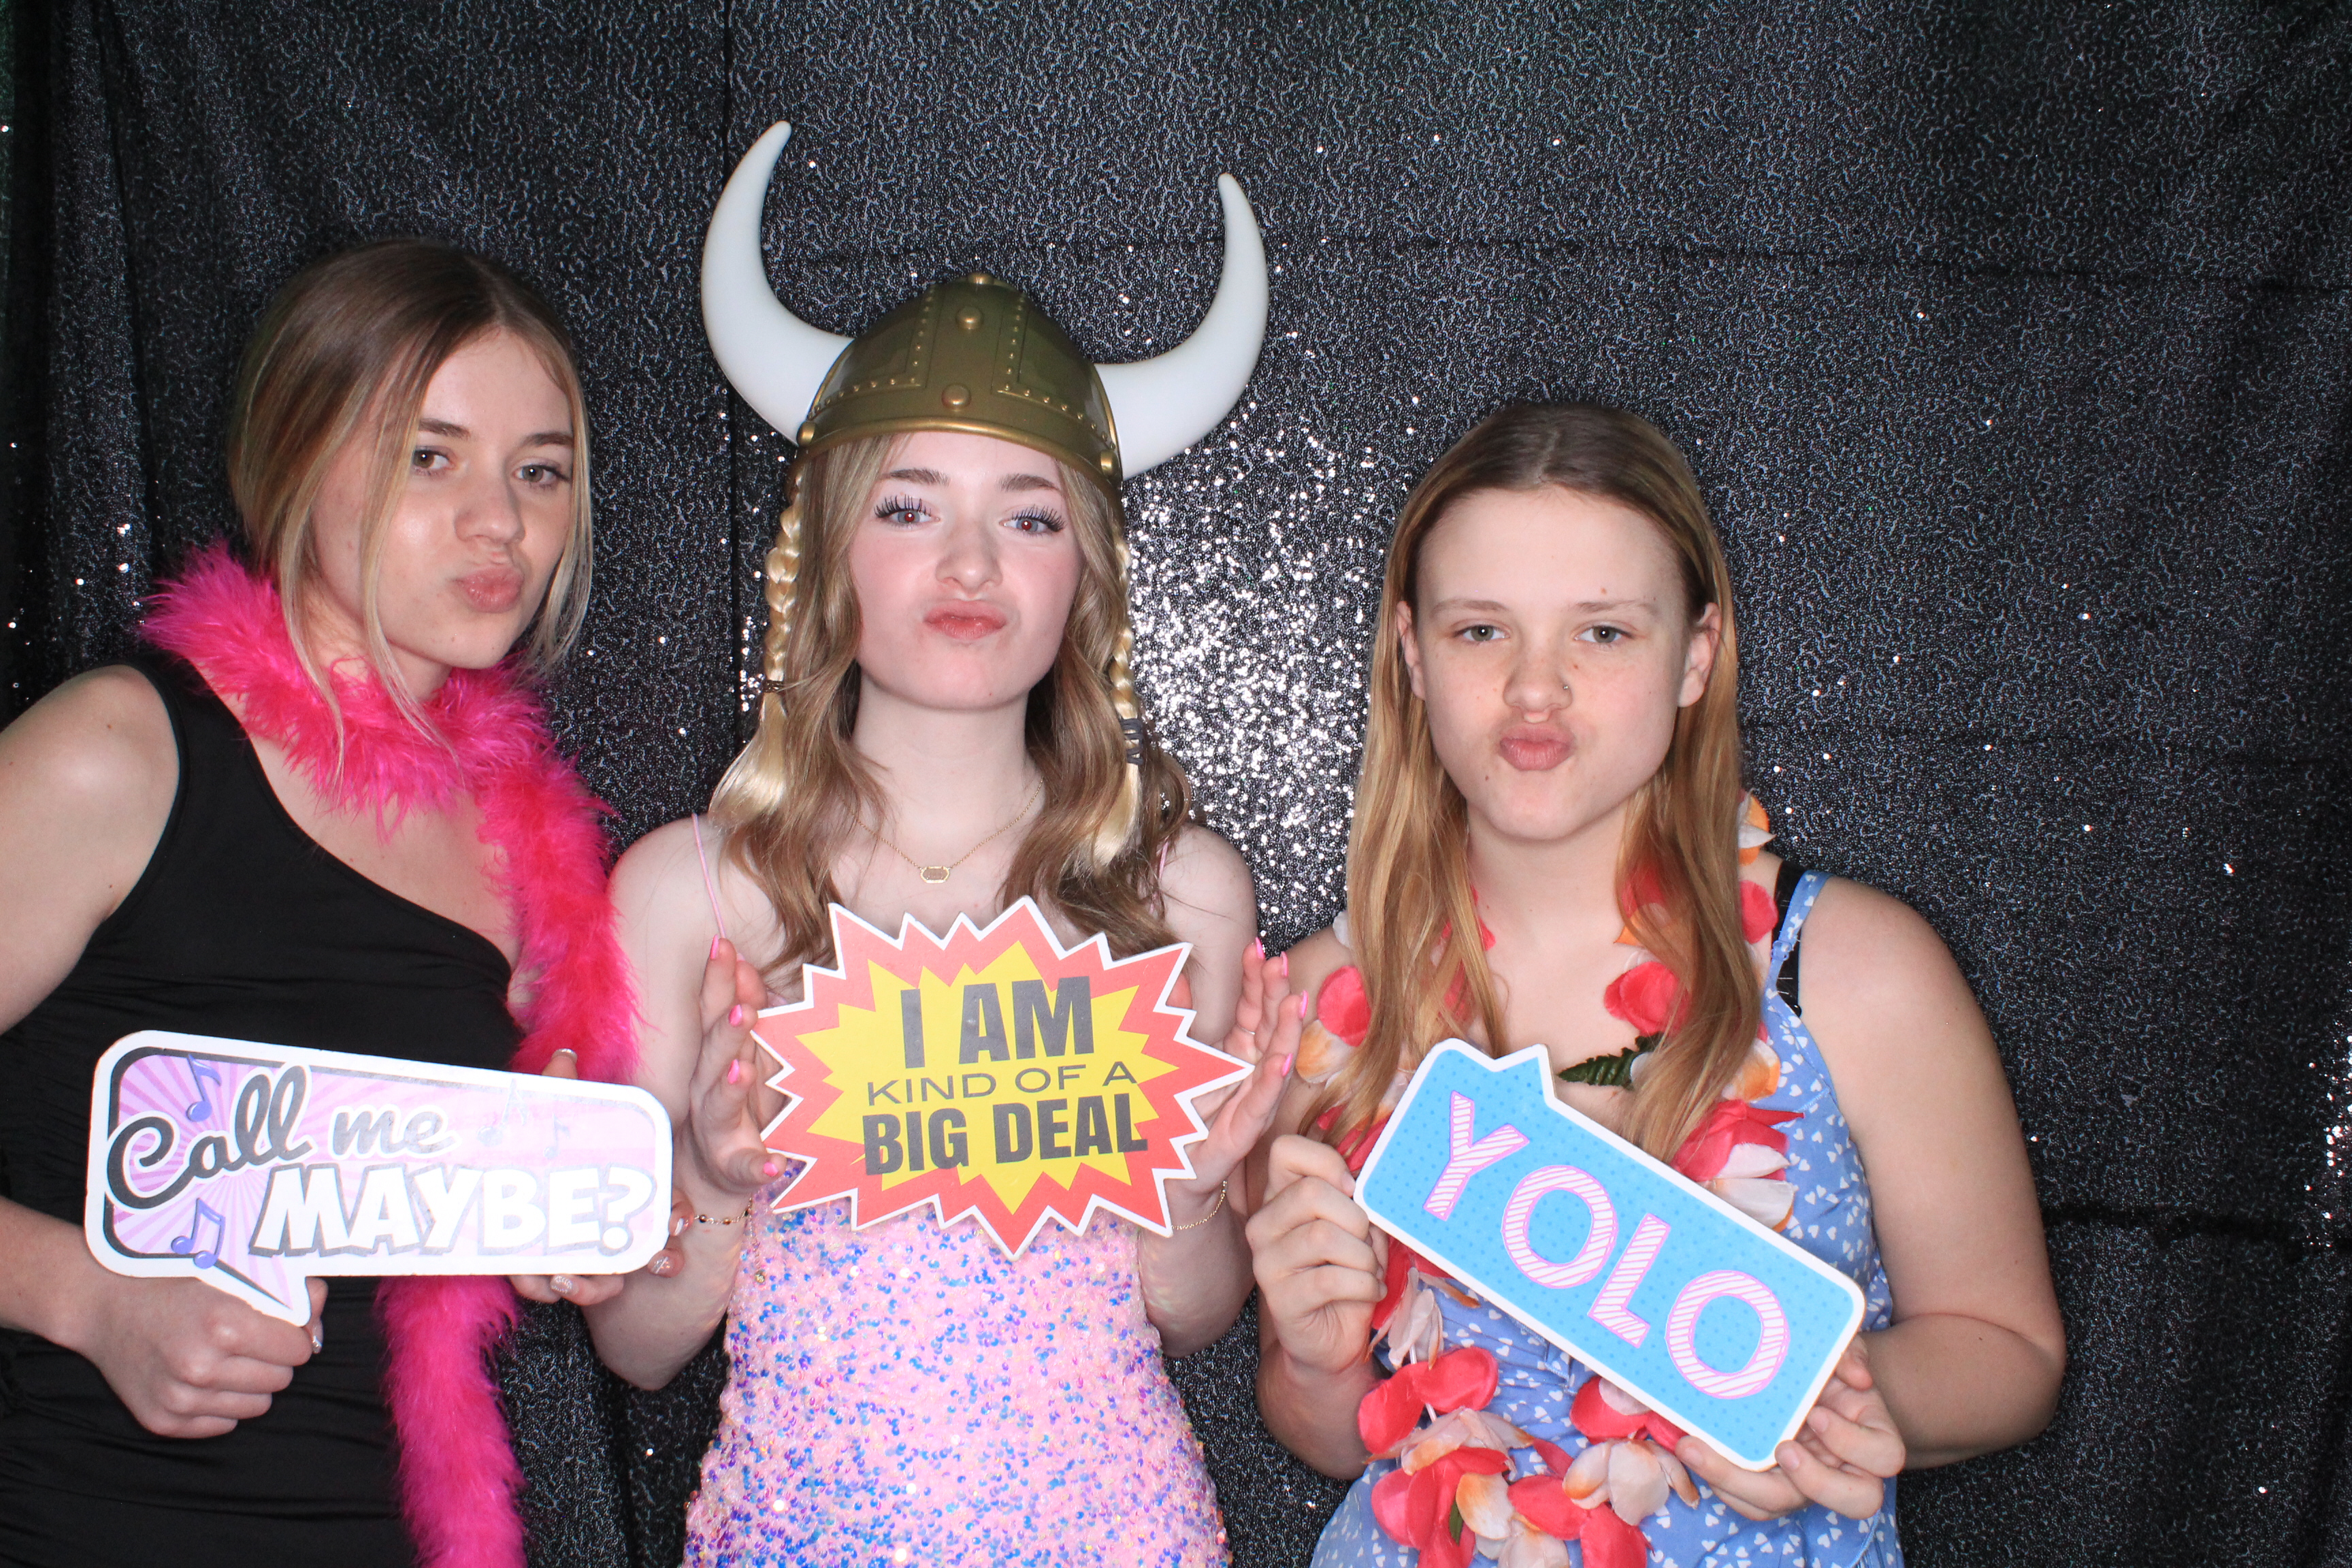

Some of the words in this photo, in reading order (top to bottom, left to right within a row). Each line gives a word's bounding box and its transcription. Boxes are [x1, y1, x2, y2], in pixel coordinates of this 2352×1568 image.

[900, 989, 926, 1069] I
[958, 976, 1095, 1064] AM
[868, 1073, 997, 1107] KIND
[1015, 1064, 1088, 1094] OF
[1102, 1061, 1138, 1087] A
[107, 1064, 313, 1209] Call
[331, 1110, 457, 1156] me
[862, 1107, 969, 1177] BIG
[992, 1092, 1149, 1164] DEAL
[249, 1162, 655, 1258] MAYBE?
[1422, 1090, 1791, 1400] YOLO
